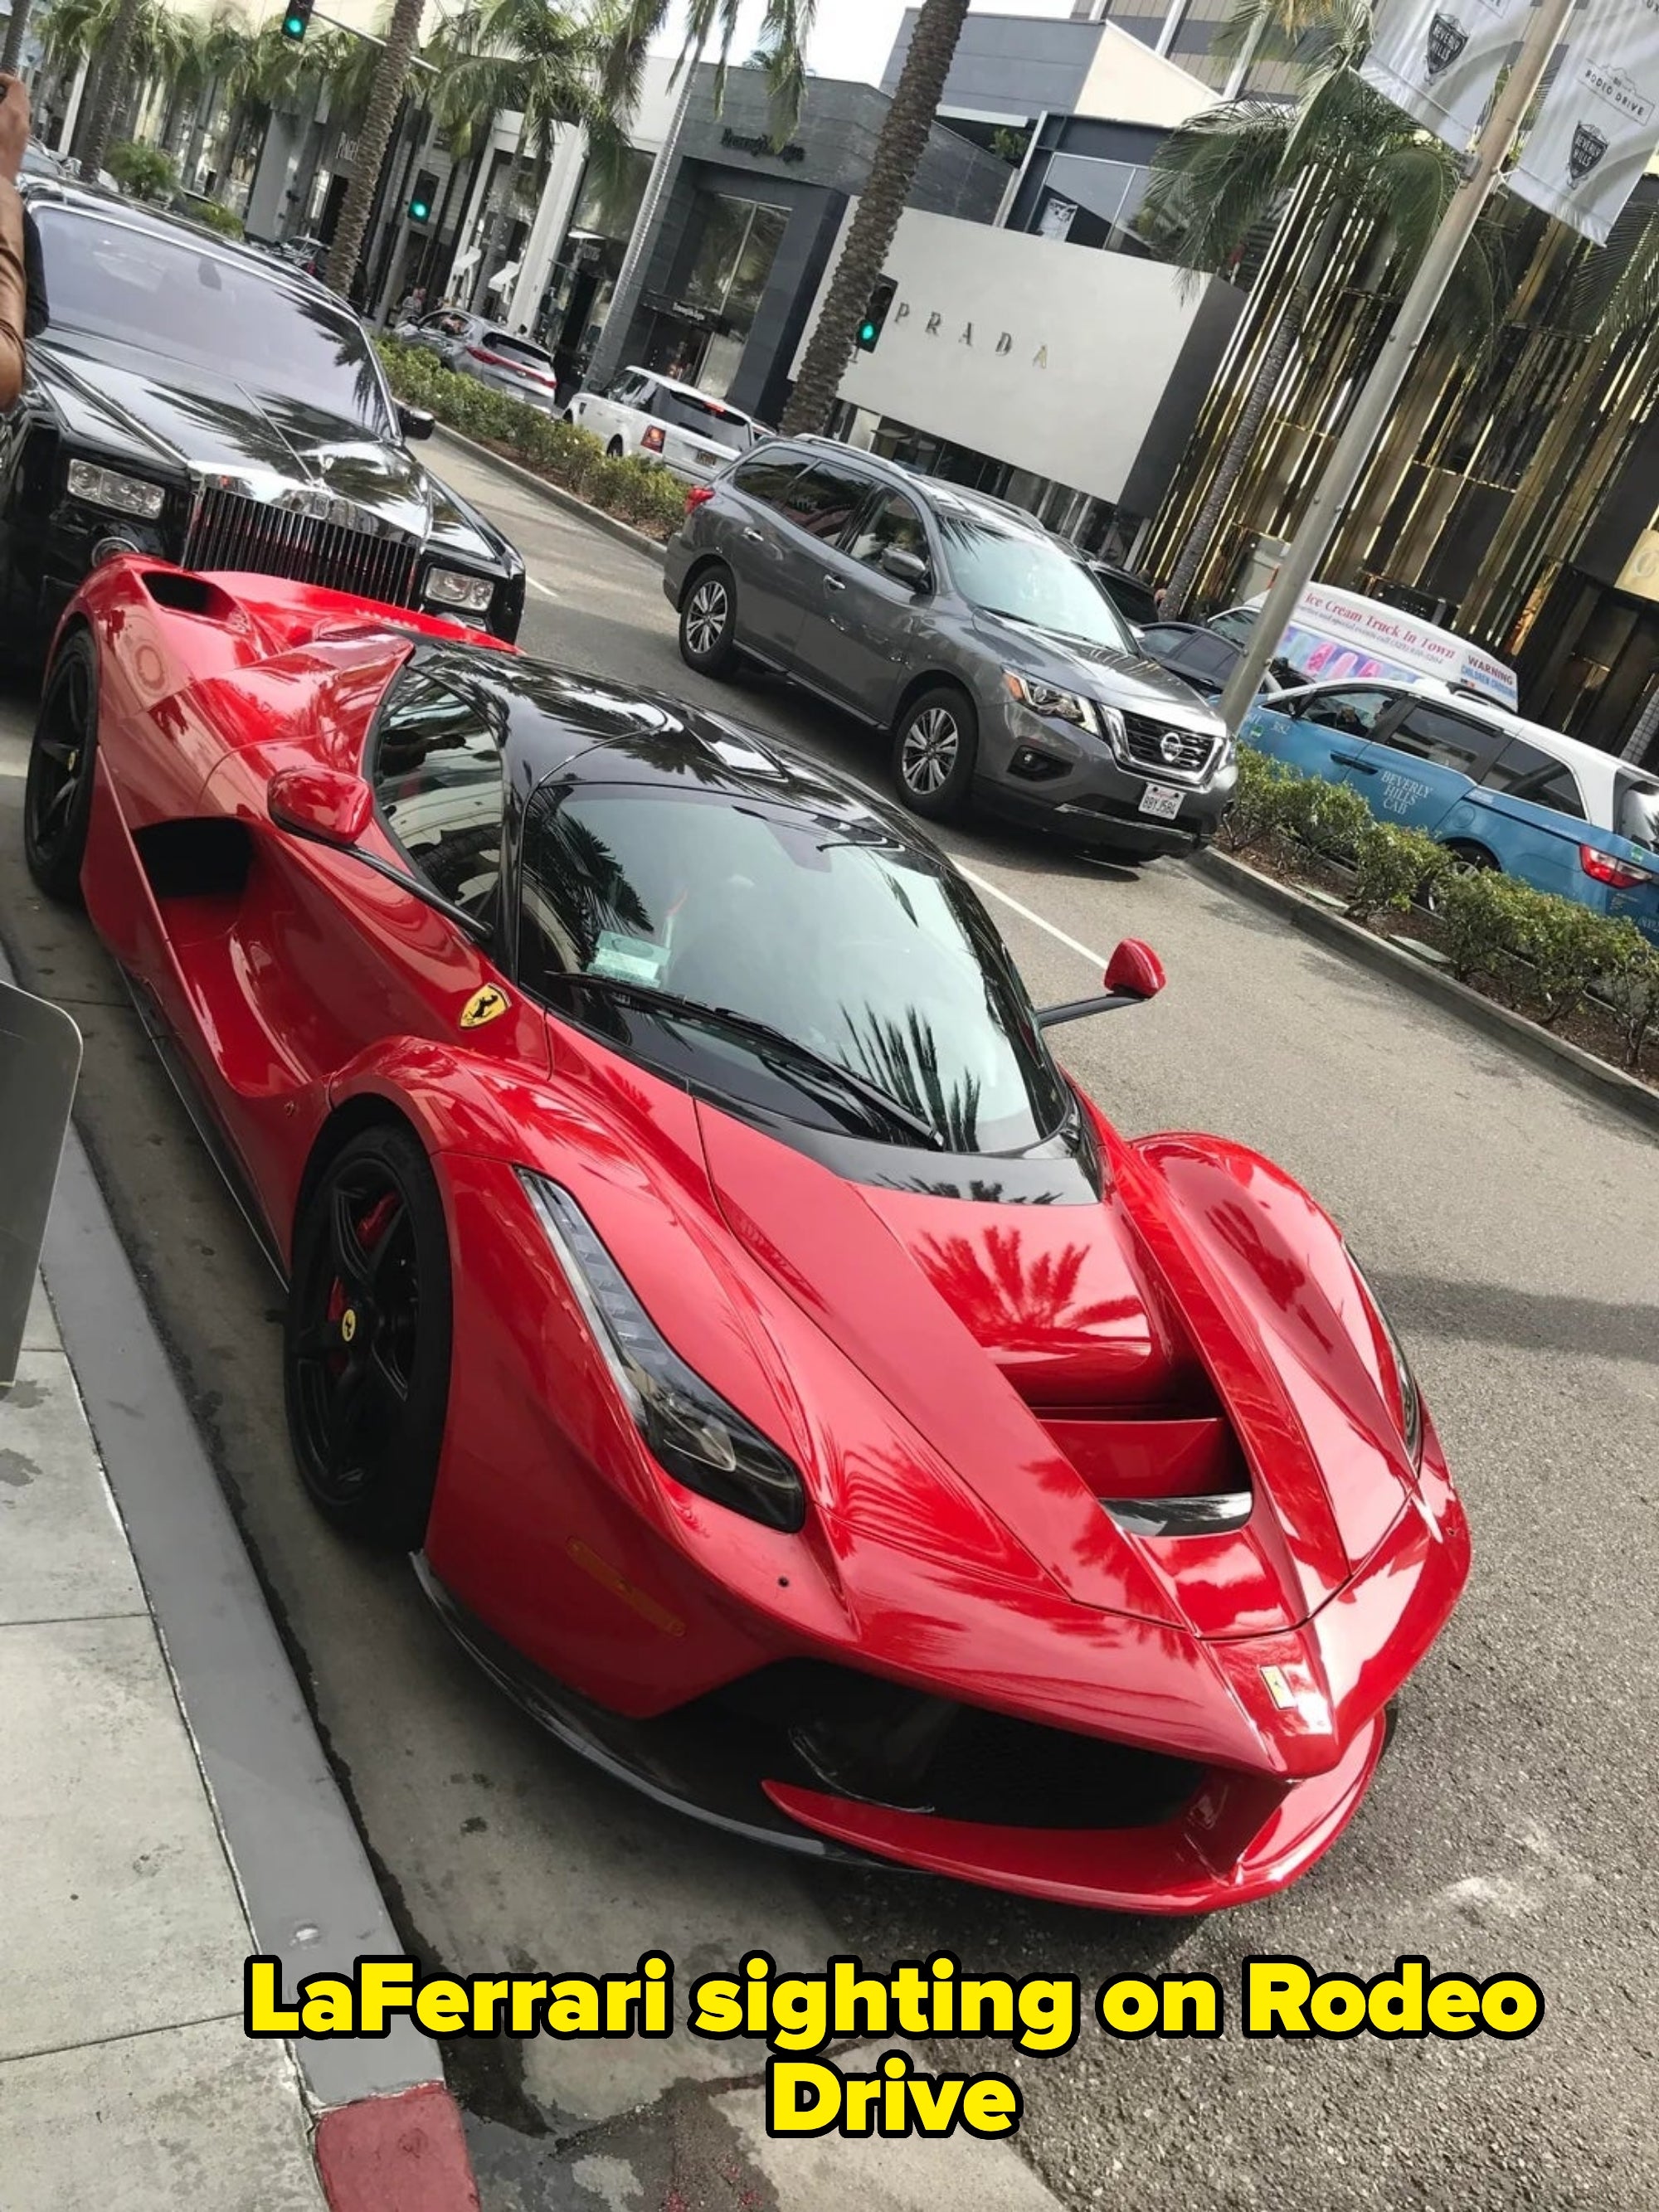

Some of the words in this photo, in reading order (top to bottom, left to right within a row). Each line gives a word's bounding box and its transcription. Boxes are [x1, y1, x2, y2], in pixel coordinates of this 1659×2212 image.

[1614, 92, 1645, 116] DRIVE
[894, 302, 1048, 369] PRADA
[1305, 593, 1324, 607] Ice
[1325, 600, 1363, 622] Cream
[1366, 615, 1402, 637] Truck
[1404, 630, 1418, 644] In
[1421, 638, 1457, 659] Town
[1468, 654, 1513, 686] WARNING
[1381, 771, 1434, 798] BEVERLY
[1384, 784, 1417, 806] HILLS
[1383, 796, 1408, 814] CAB
